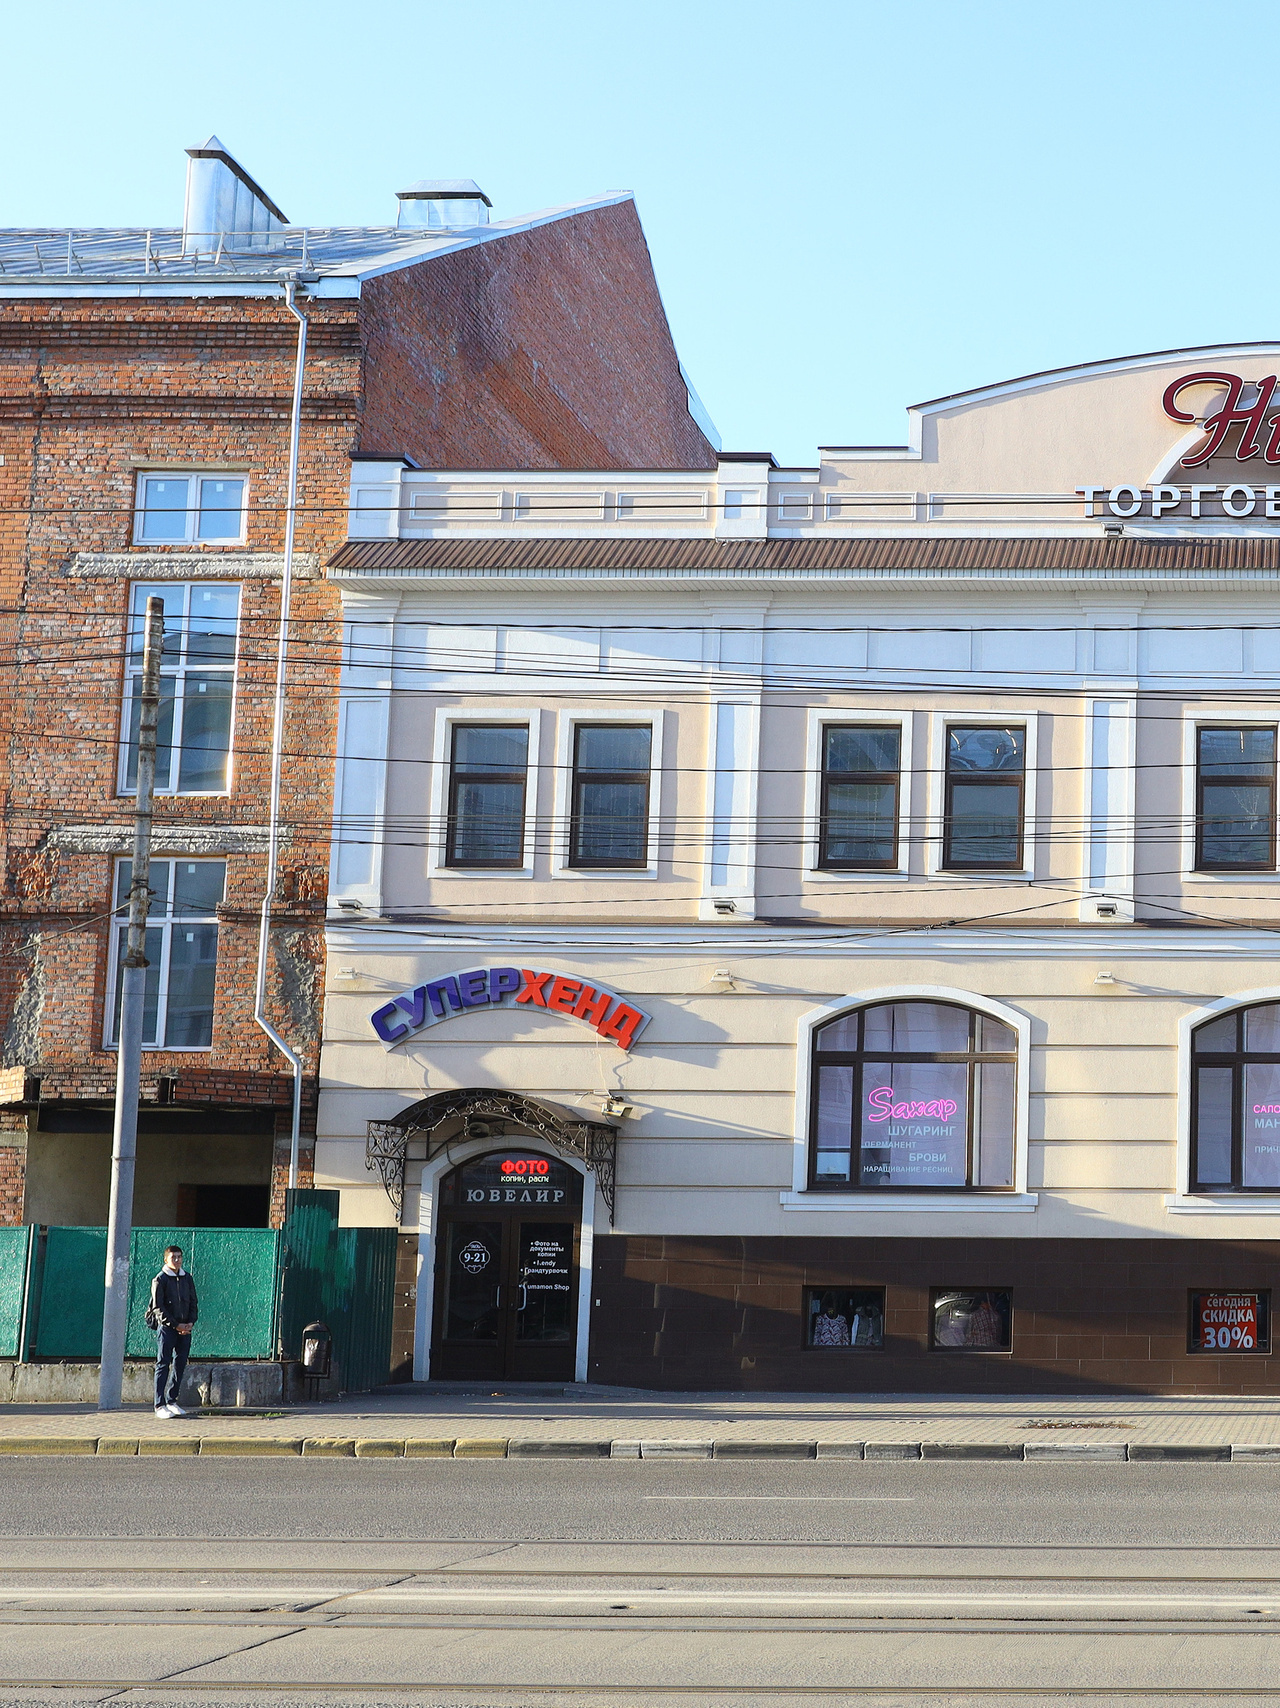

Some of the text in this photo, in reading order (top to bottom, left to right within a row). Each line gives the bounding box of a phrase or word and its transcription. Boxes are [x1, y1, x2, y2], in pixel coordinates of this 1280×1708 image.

[371, 967, 644, 1050] СУПЕРХЕНД
[888, 1125, 956, 1136] ШУГАРИНГ
[864, 1141, 917, 1149] ПЕРМАНЕНТ
[909, 1153, 947, 1162] БРОВИ
[501, 1160, 549, 1175] ФОТО
[863, 1165, 920, 1173] НАРАЩИВАНИЕ
[501, 1175, 527, 1184] копии,
[466, 1189, 564, 1203] ЮВЕЛИР
[464, 1252, 486, 1263] 9-21
[1207, 1297, 1251, 1309] сегодня
[1202, 1309, 1255, 1325] СКИДКА
[1203, 1326, 1253, 1349] 30%
